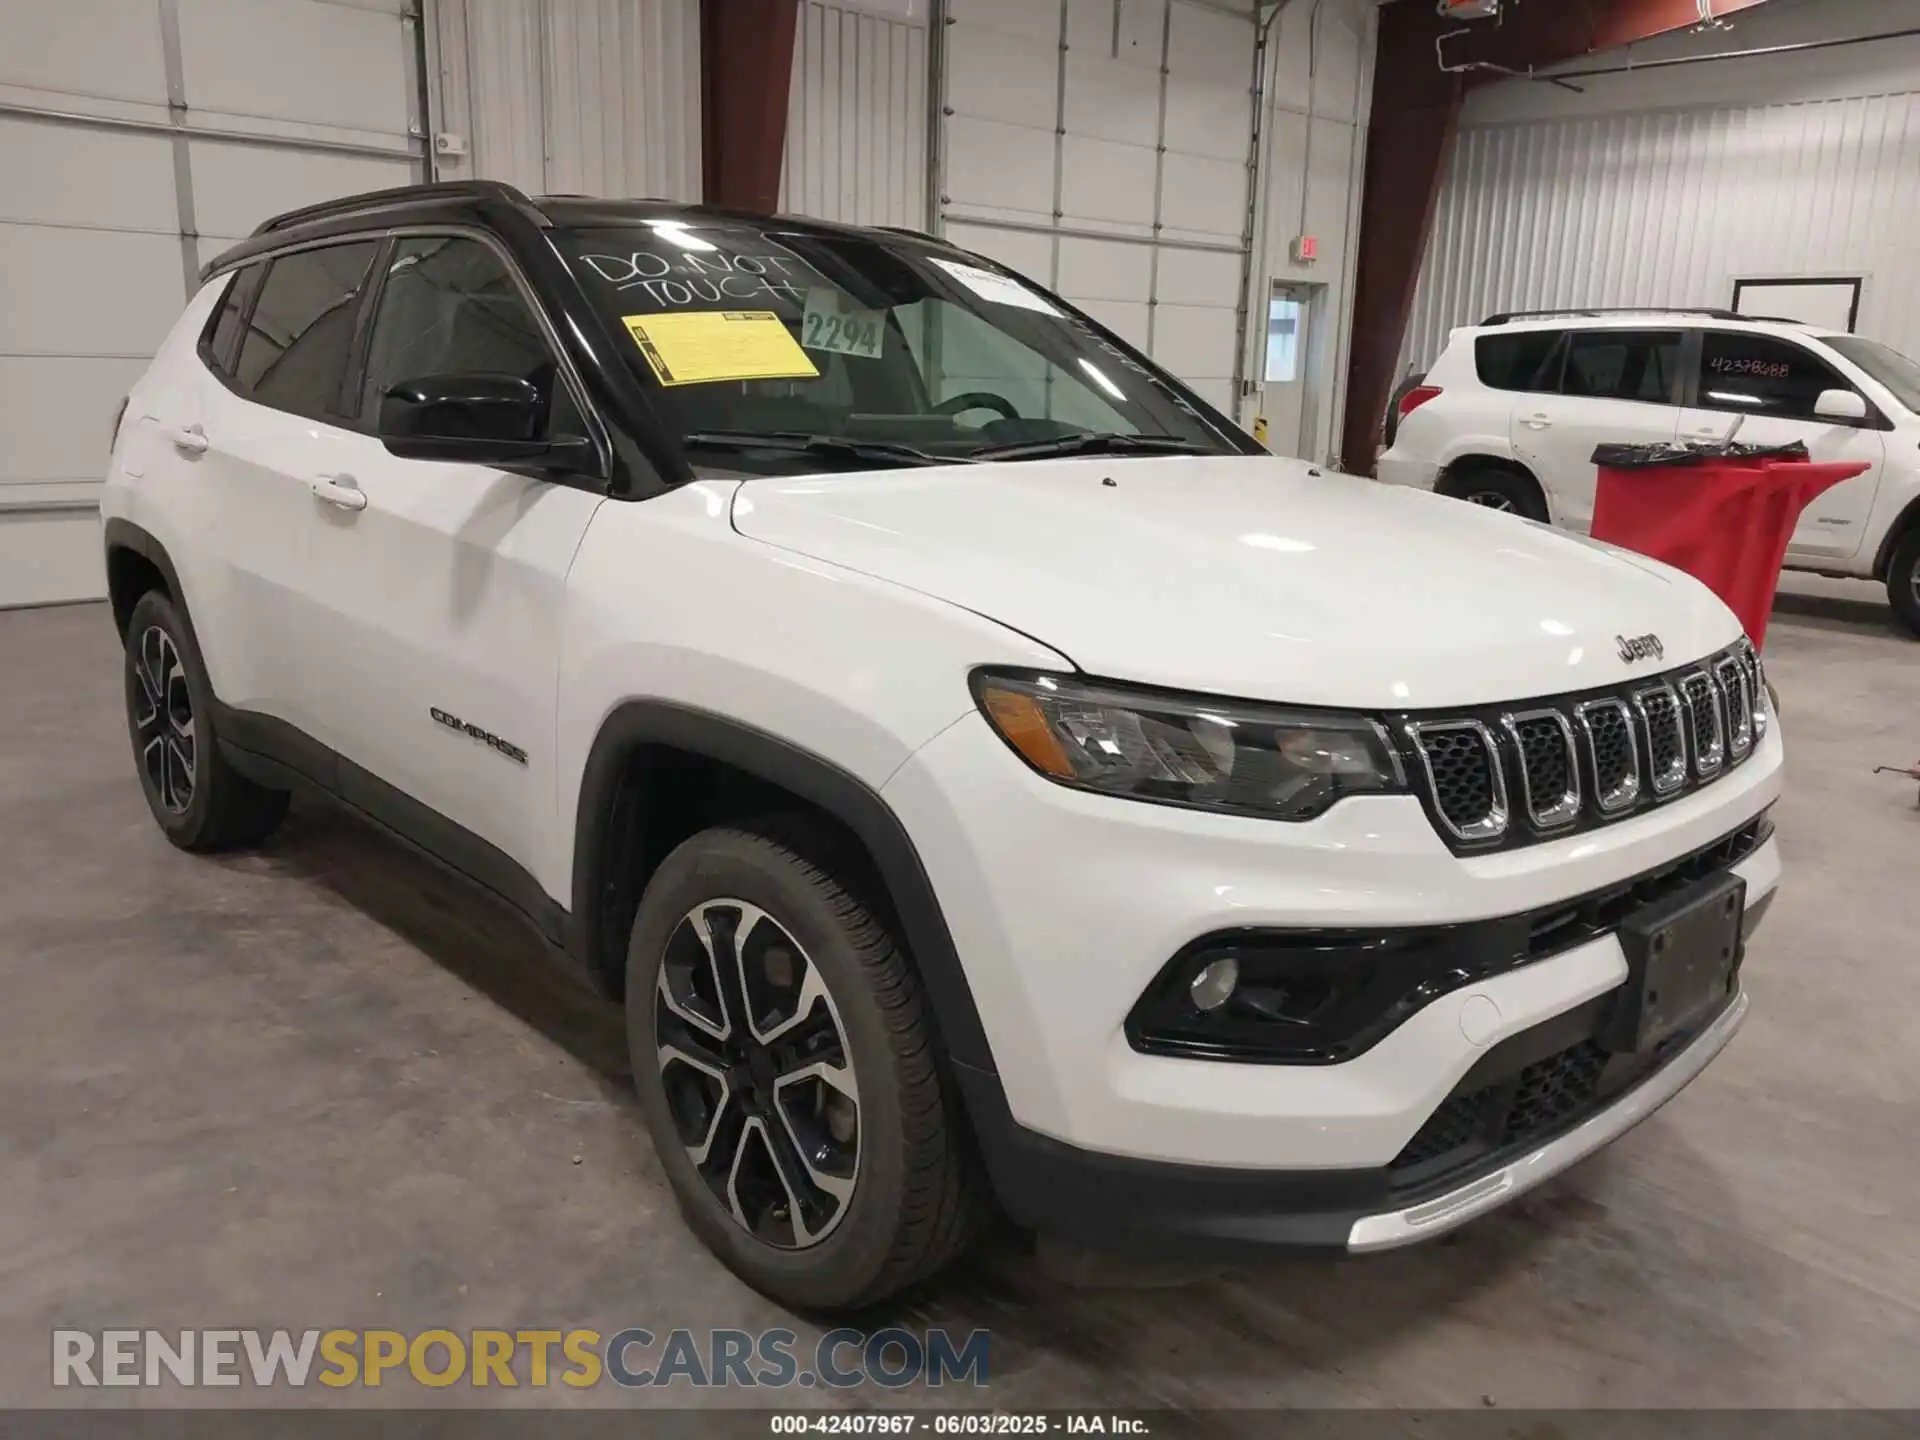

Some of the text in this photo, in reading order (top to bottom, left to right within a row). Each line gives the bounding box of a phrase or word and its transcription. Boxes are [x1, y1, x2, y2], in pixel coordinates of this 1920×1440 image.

[579, 252, 793, 282] DO NOT
[616, 277, 808, 307] TOUCH
[806, 312, 876, 355] 2294
[1616, 633, 1664, 665] Jeep
[430, 706, 528, 764] COMPASS
